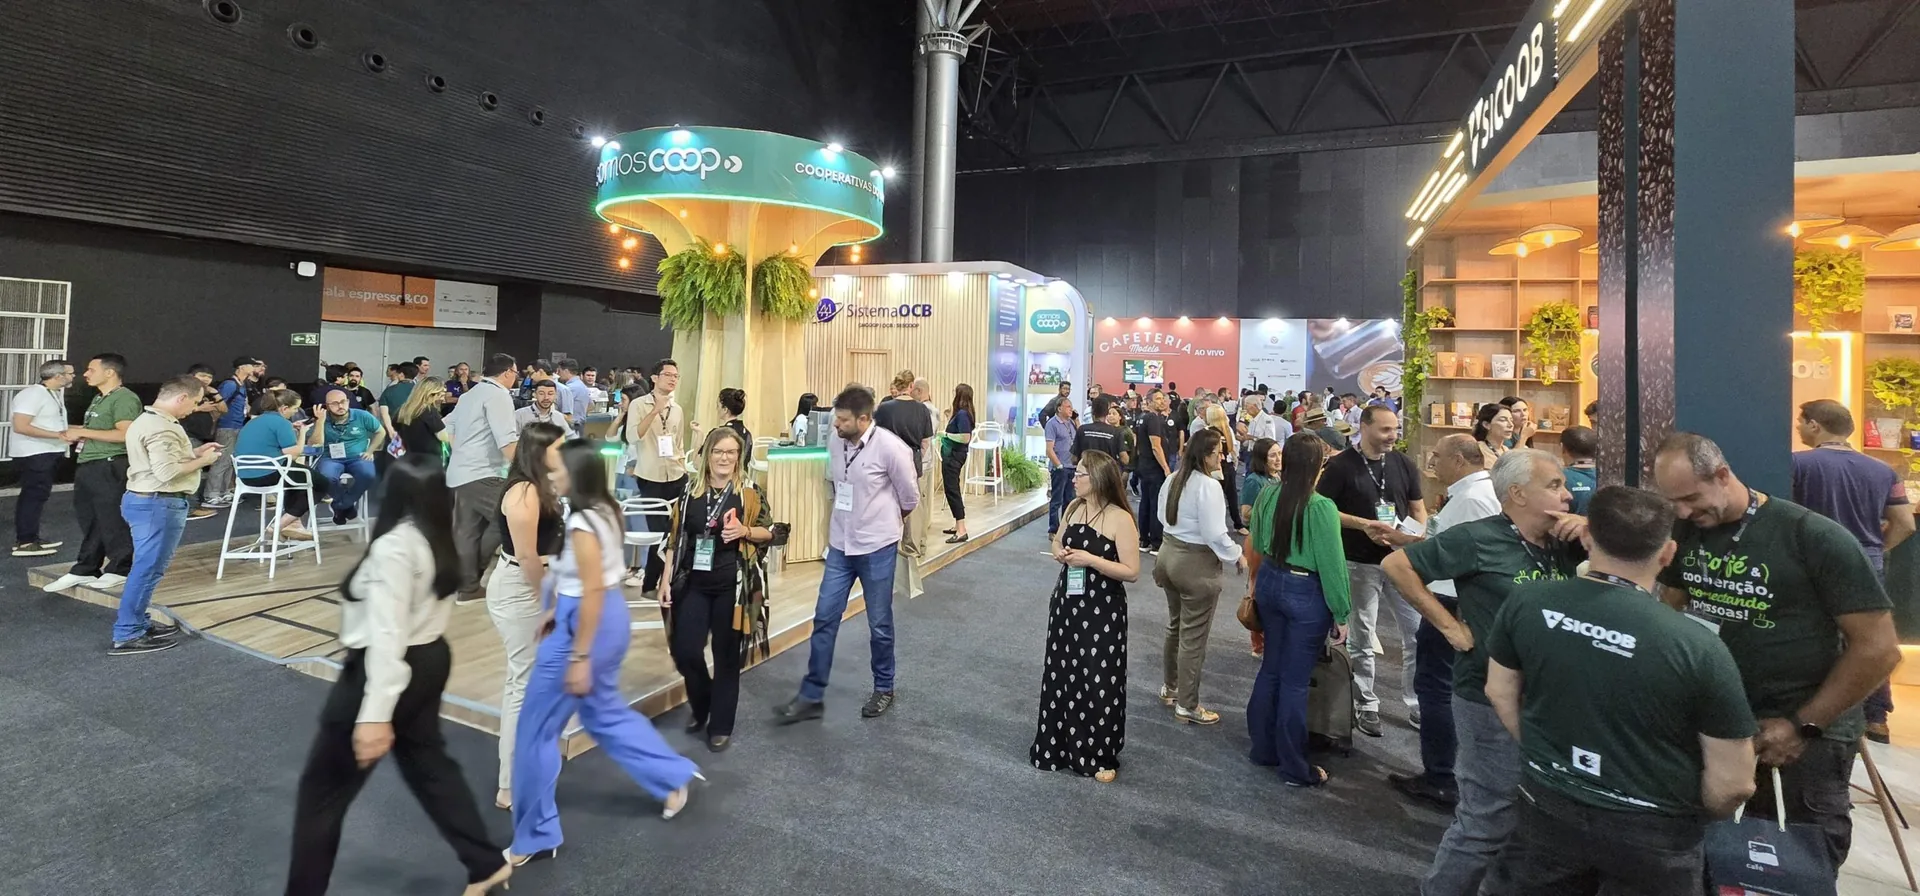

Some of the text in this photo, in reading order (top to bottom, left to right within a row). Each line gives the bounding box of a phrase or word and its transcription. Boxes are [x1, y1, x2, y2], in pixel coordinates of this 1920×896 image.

[1480, 22, 1544, 149] SICOOB
[795, 162, 872, 192] COOPERATIVAS
[846, 304, 932, 318] SistemaOCB
[1099, 331, 1192, 355] CAFETERIA
[1128, 343, 1160, 353] Modelo
[1194, 349, 1225, 357] AO VIVO
[1561, 616, 1637, 649] SICOOB
